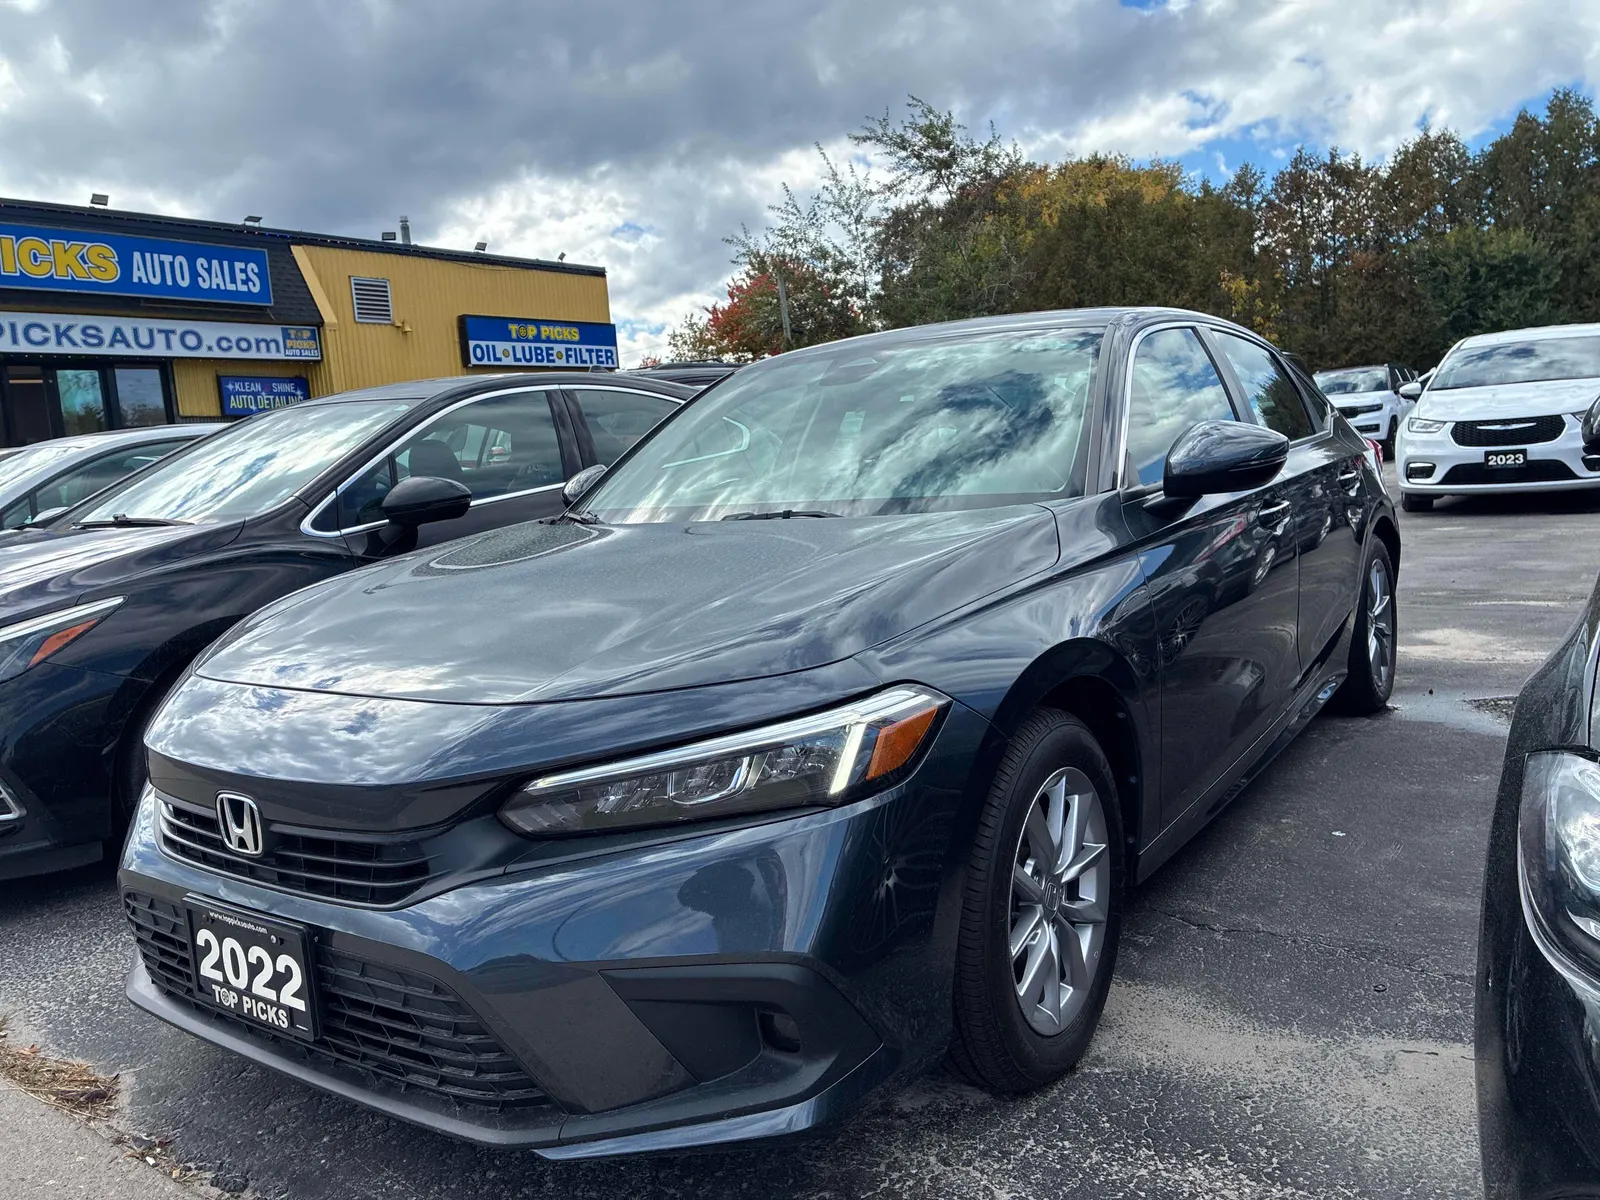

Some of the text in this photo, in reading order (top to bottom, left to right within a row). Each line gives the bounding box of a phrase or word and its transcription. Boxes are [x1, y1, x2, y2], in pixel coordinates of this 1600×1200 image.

[133, 251, 190, 288] AUTO
[196, 257, 260, 293] SALES
[508, 323, 579, 341] TOP PICKS
[472, 343, 615, 365] OIL LUBE FILTER
[234, 382, 261, 392] KLEAN
[272, 383, 295, 393] SHINE
[230, 395, 255, 409] AUTO
[1488, 453, 1524, 466] 2023
[196, 928, 306, 1011] 2022
[211, 984, 289, 1028] TOP PICKS
